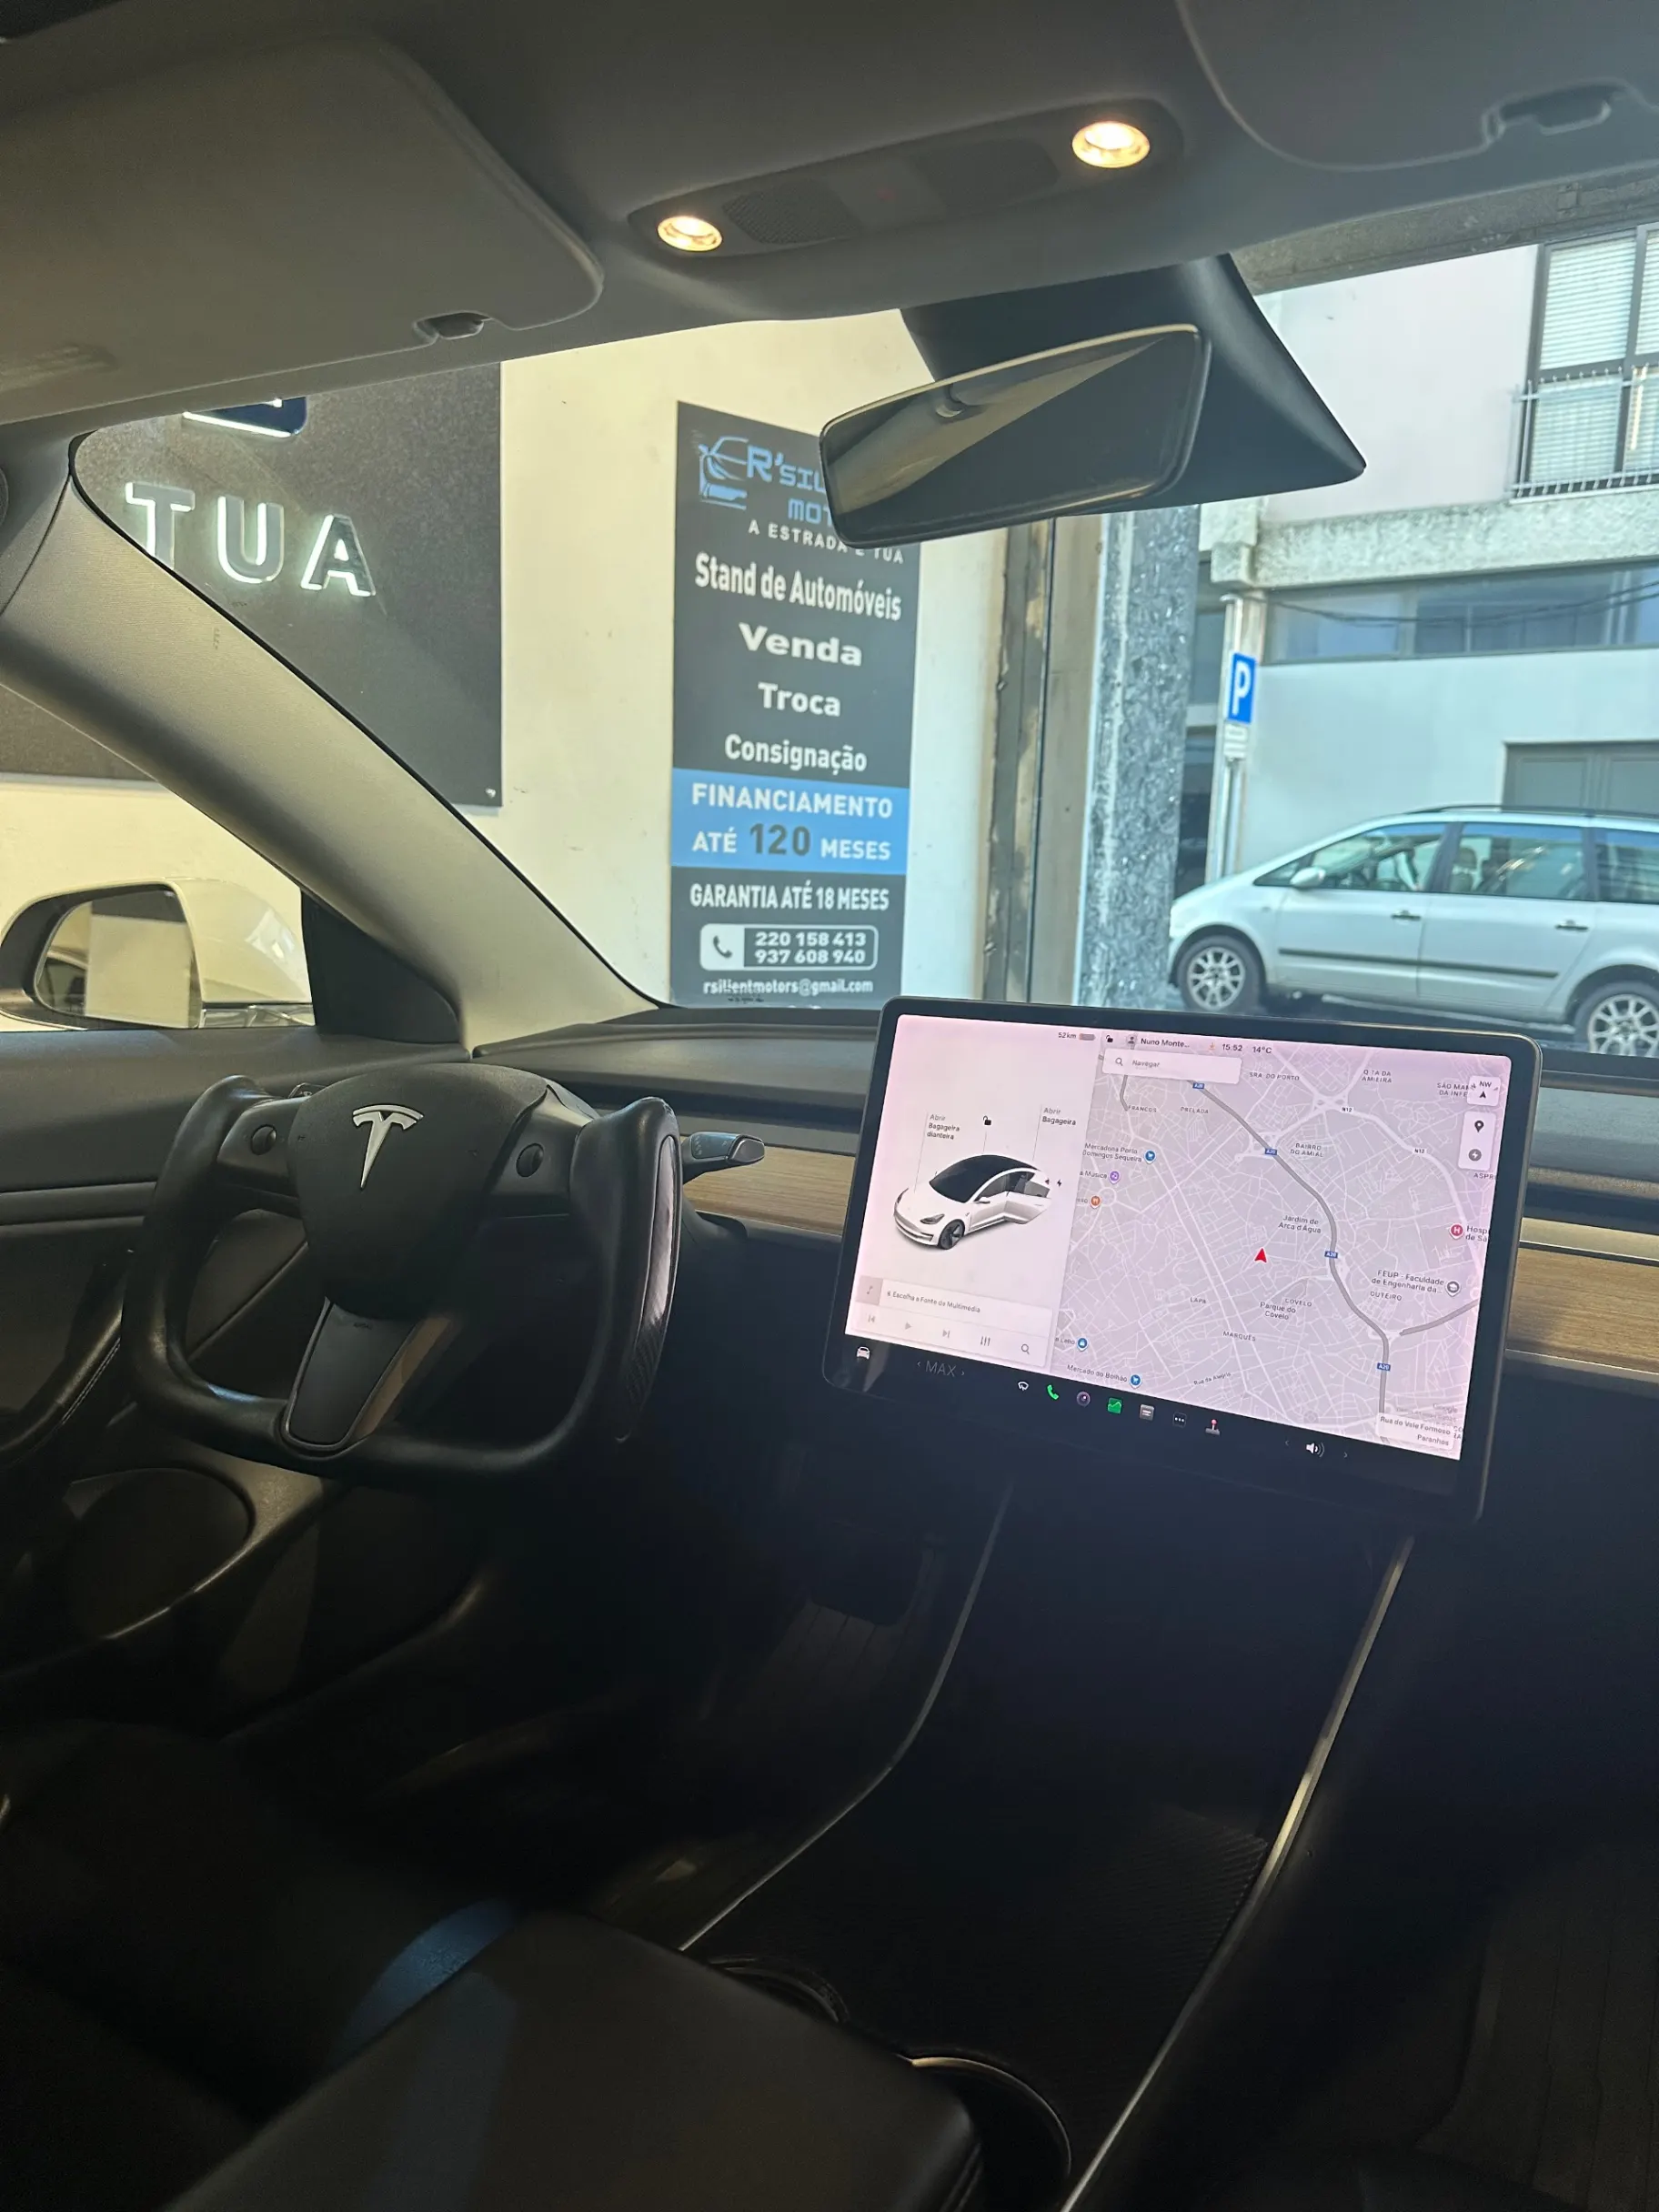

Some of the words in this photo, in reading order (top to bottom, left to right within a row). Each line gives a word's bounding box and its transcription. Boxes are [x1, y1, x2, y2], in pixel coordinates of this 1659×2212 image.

[126, 481, 376, 597] TUA
[749, 519, 759, 535] A
[768, 522, 848, 553] ESTRADA
[695, 551, 757, 597] Stand
[760, 565, 787, 601] de
[789, 569, 902, 621] Automóveis
[739, 622, 863, 667] Venda
[1232, 660, 1252, 716] P
[758, 681, 841, 717] Troca
[725, 733, 868, 775] Consignação
[691, 782, 893, 819] FINANCIAMENTO
[691, 826, 738, 853] ATÉ
[749, 822, 811, 856] 120
[820, 838, 891, 860] MESES
[689, 883, 779, 908] GARANTIA
[780, 880, 812, 909] ATÉ
[816, 886, 835, 910] 18
[838, 888, 890, 910] MESES
[754, 931, 791, 947] 220
[796, 931, 830, 947] 158
[832, 931, 867, 947] 413
[754, 949, 791, 964] 937
[794, 949, 829, 964] 608
[832, 949, 866, 964] 940
[1058, 1031, 1077, 1040] 52km
[1141, 1038, 1160, 1046] Nuno
[1252, 1045, 1272, 1054] 14°C
[1132, 1059, 1160, 1069] Navegar
[1043, 1107, 1061, 1115] Abrir
[1180, 1106, 1209, 1114] PRELADA
[930, 1113, 946, 1121] Abrir
[1041, 1115, 1077, 1127] Bagageira
[928, 1122, 960, 1132] Bagageira
[927, 1131, 955, 1141] dianteira
[1295, 1142, 1322, 1151] BAIRRO
[1282, 1214, 1308, 1224] Jardim
[1278, 1222, 1295, 1230] Arca
[1377, 1270, 1399, 1278] FEUP
[1405, 1273, 1444, 1285] Faculdade
[1382, 1279, 1425, 1292] Engenharia
[920, 1296, 938, 1305] Fonte
[1284, 1298, 1312, 1307] COVELO
[1370, 1291, 1403, 1302] OUTEIRO
[1260, 1301, 1285, 1312] Parque
[1264, 1310, 1290, 1321] Covelo
[925, 1360, 958, 1377] MAX
[1066, 1364, 1094, 1376] Mercado
[1380, 1416, 1393, 1424] Rua
[1404, 1421, 1420, 1430] Vale
[1420, 1423, 1451, 1435] Formoso
[1417, 1434, 1450, 1446] Paranhos
